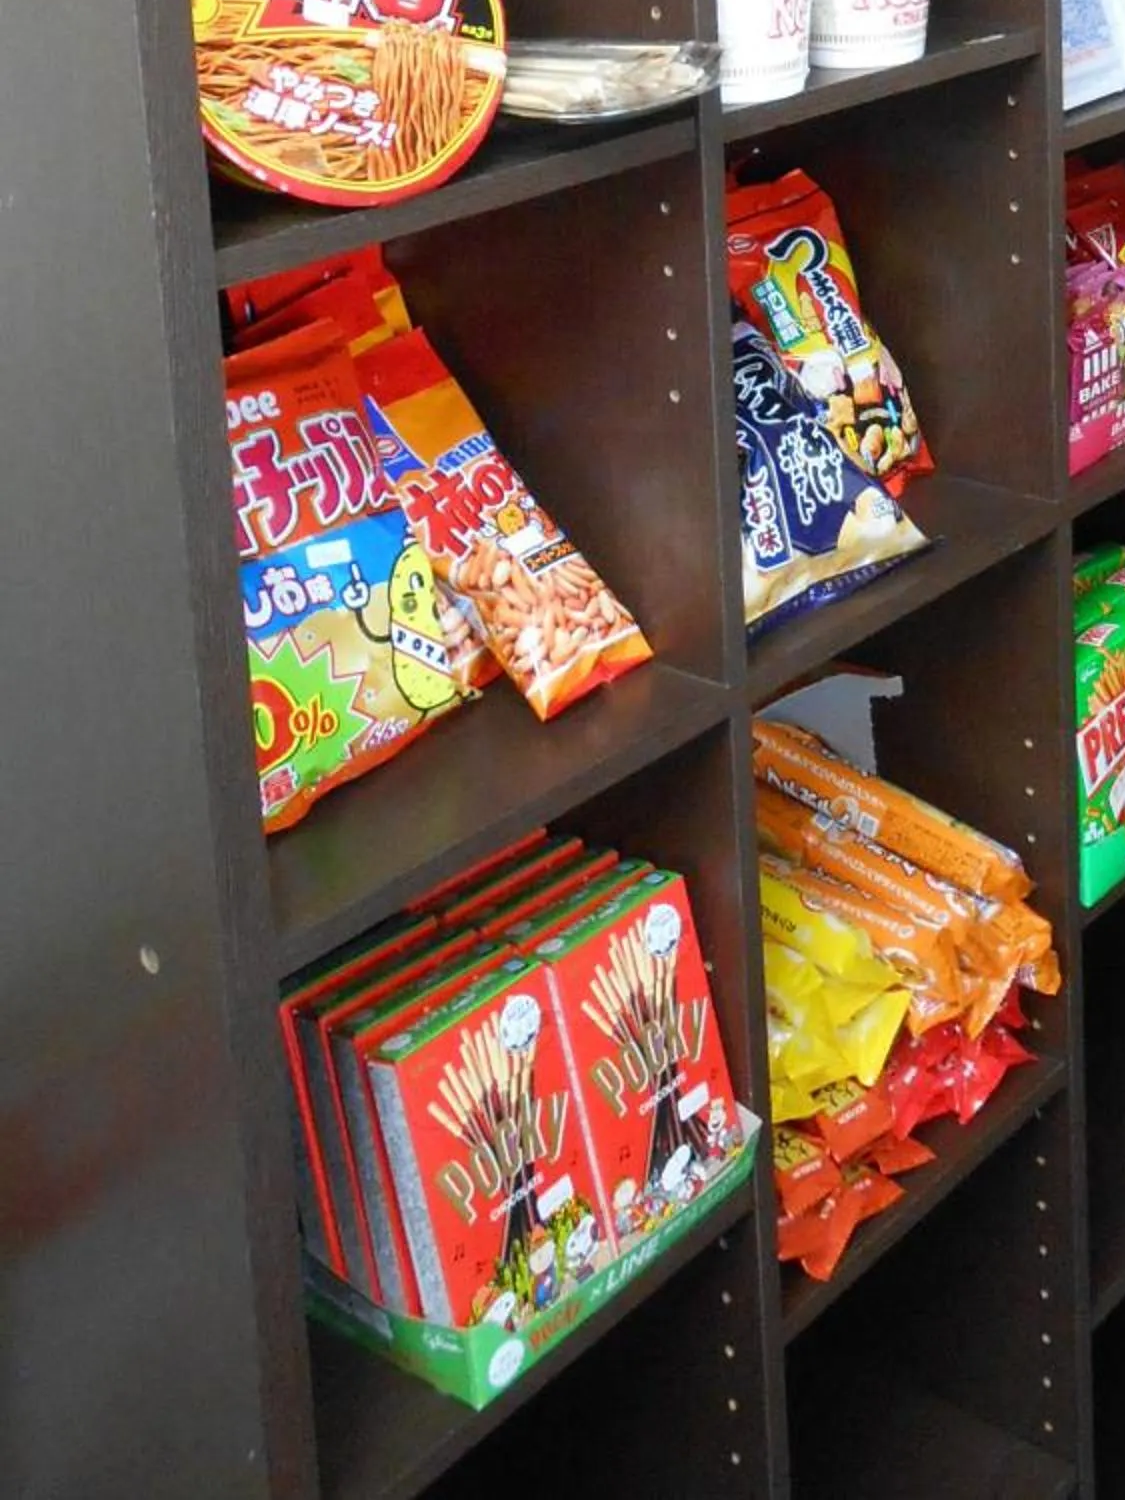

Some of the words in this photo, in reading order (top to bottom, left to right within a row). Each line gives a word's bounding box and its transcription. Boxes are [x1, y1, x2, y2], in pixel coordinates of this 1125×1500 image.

[268, 65, 381, 117] やみつき
[1079, 369, 1121, 405] BAKE
[605, 1237, 661, 1294] LINE
